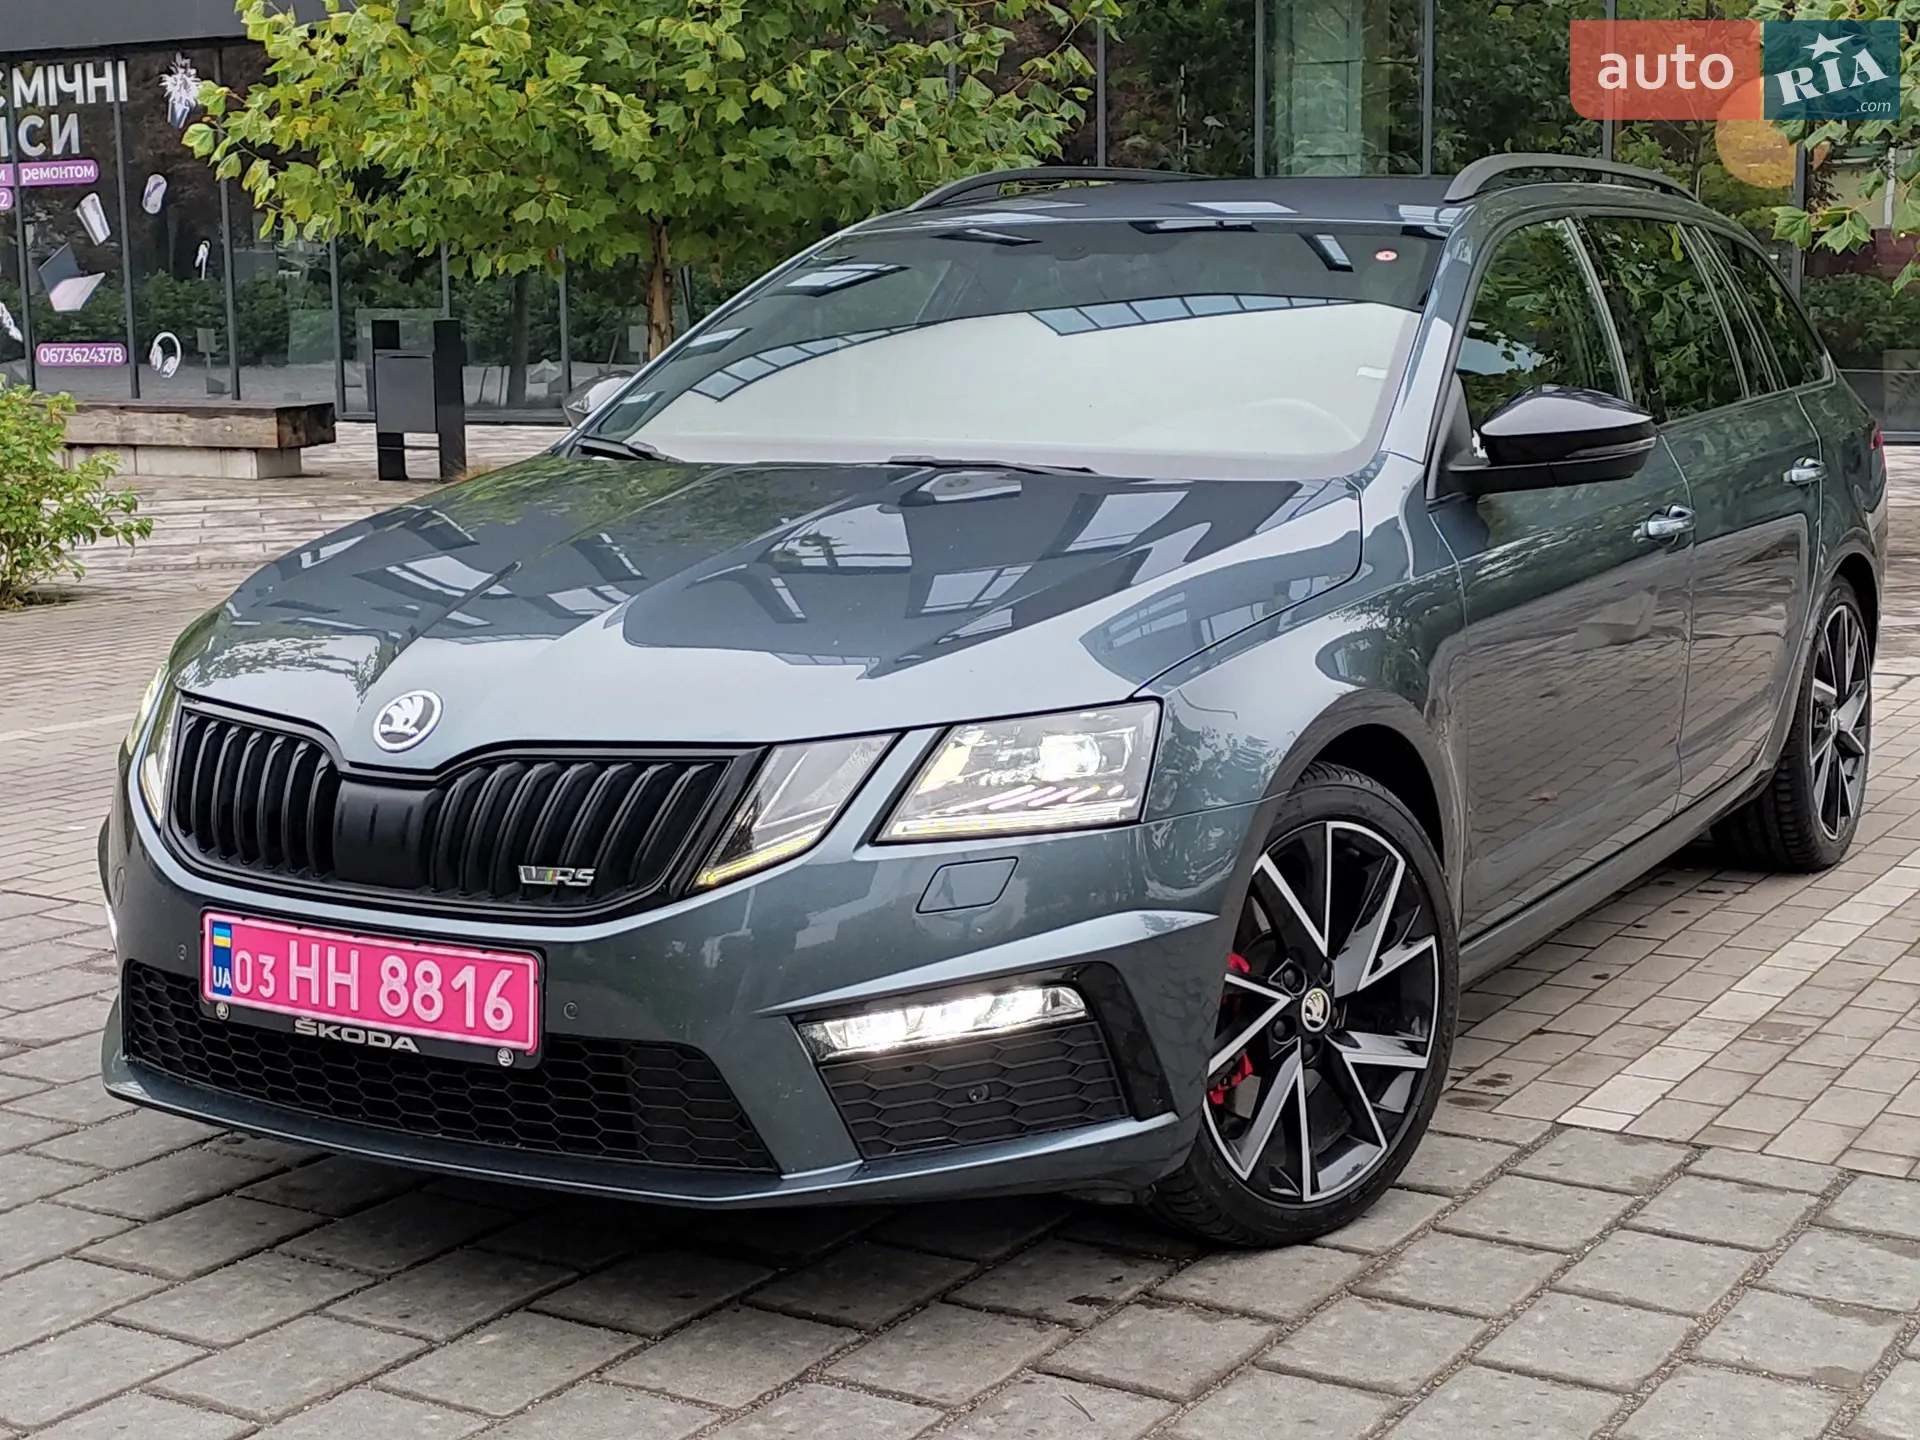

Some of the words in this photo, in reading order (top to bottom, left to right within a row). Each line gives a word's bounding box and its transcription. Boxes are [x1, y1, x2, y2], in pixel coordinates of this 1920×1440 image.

[0, 60, 128, 108] МІЧНІ
[21, 164, 95, 184] ремонтом
[40, 347, 123, 364] 0673624378
[212, 965, 233, 991] UA
[235, 949, 276, 999] 03
[289, 939, 360, 1012] HH
[379, 954, 515, 1032] 8816
[294, 1016, 420, 1054] ŠKODA
